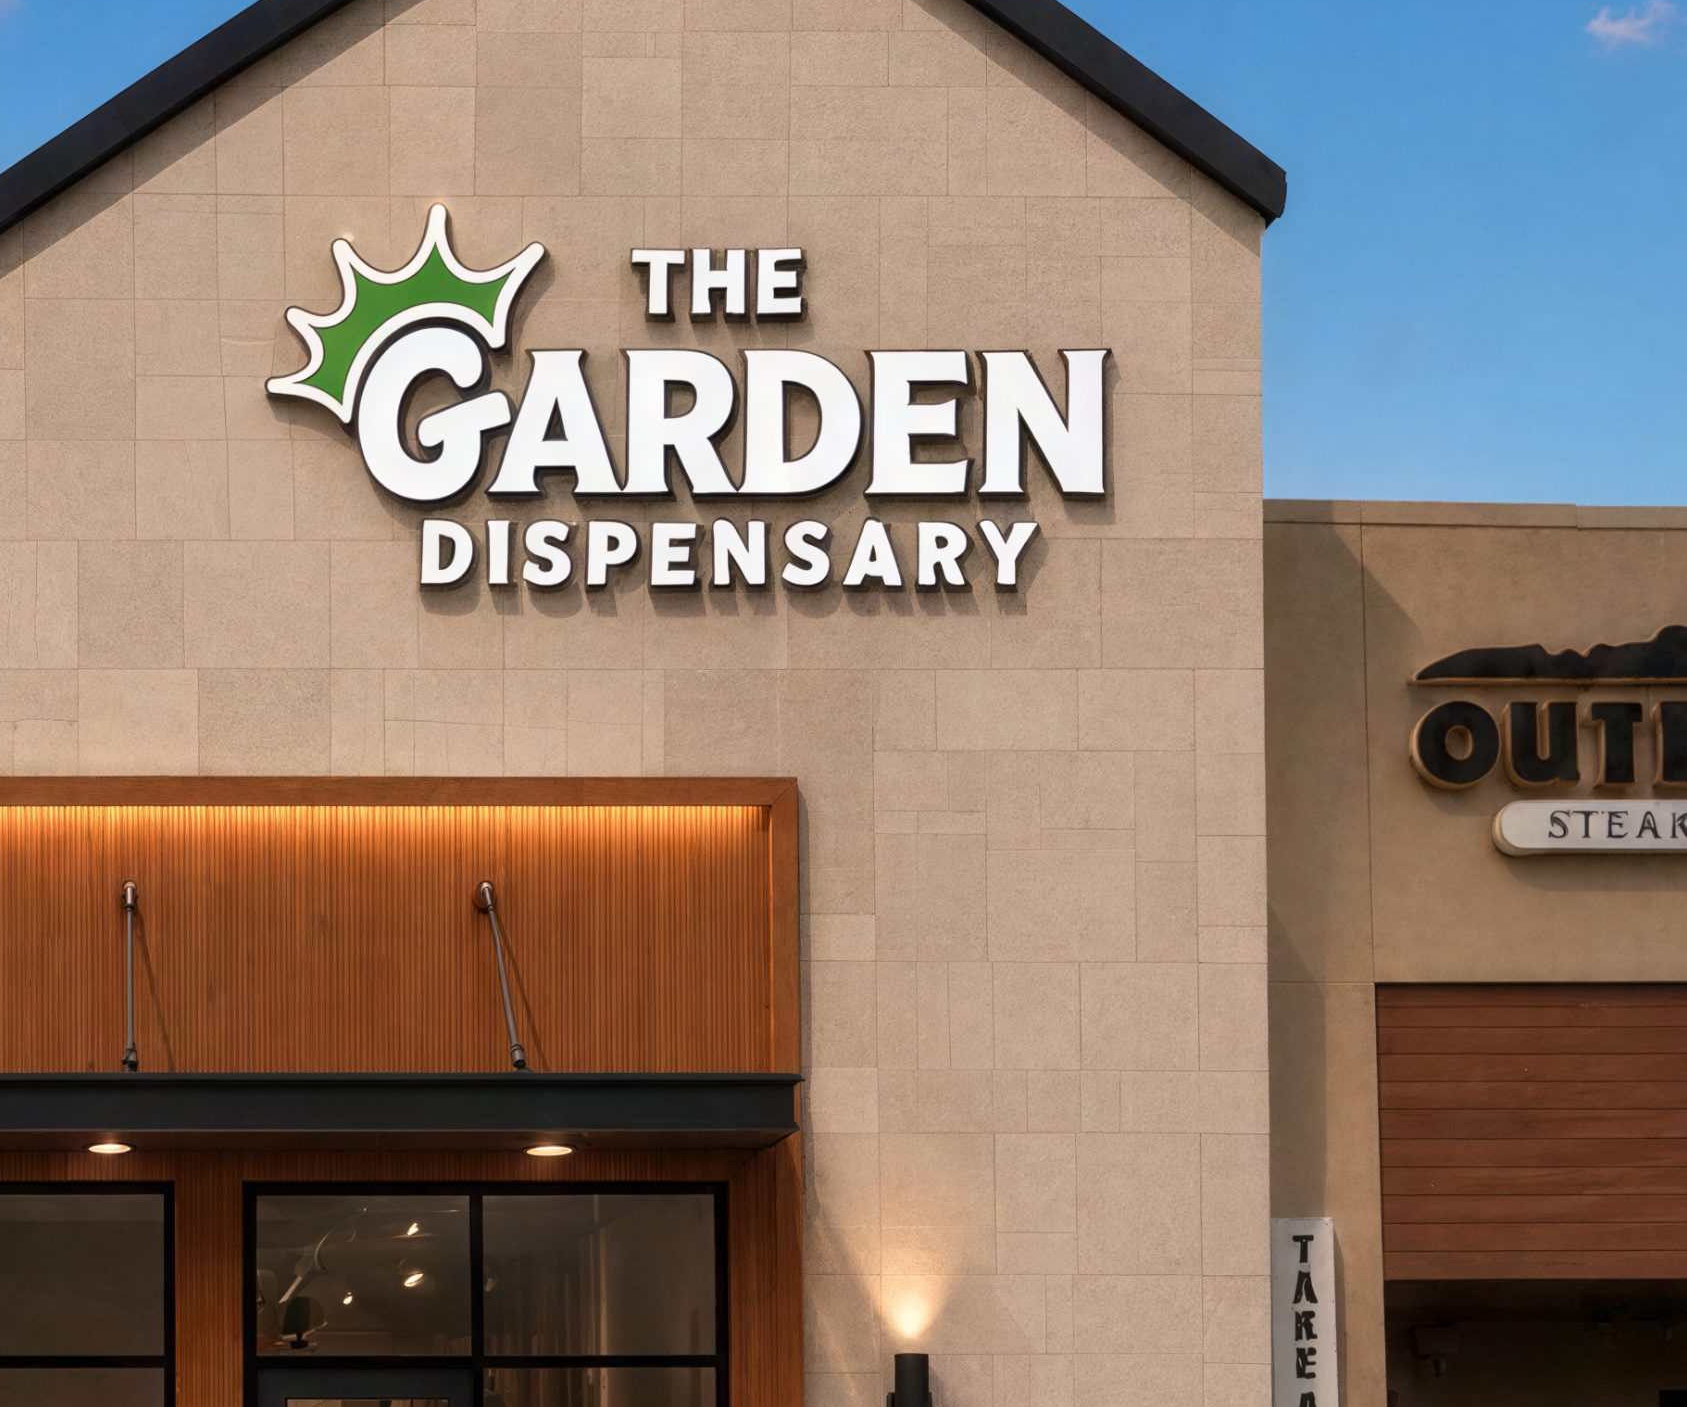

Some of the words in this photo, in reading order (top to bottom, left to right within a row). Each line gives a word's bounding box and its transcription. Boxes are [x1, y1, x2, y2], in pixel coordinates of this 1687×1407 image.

[630, 247, 806, 318] THE
[356, 324, 1112, 503] GARDEN
[418, 518, 1039, 590] DISPENSARY
